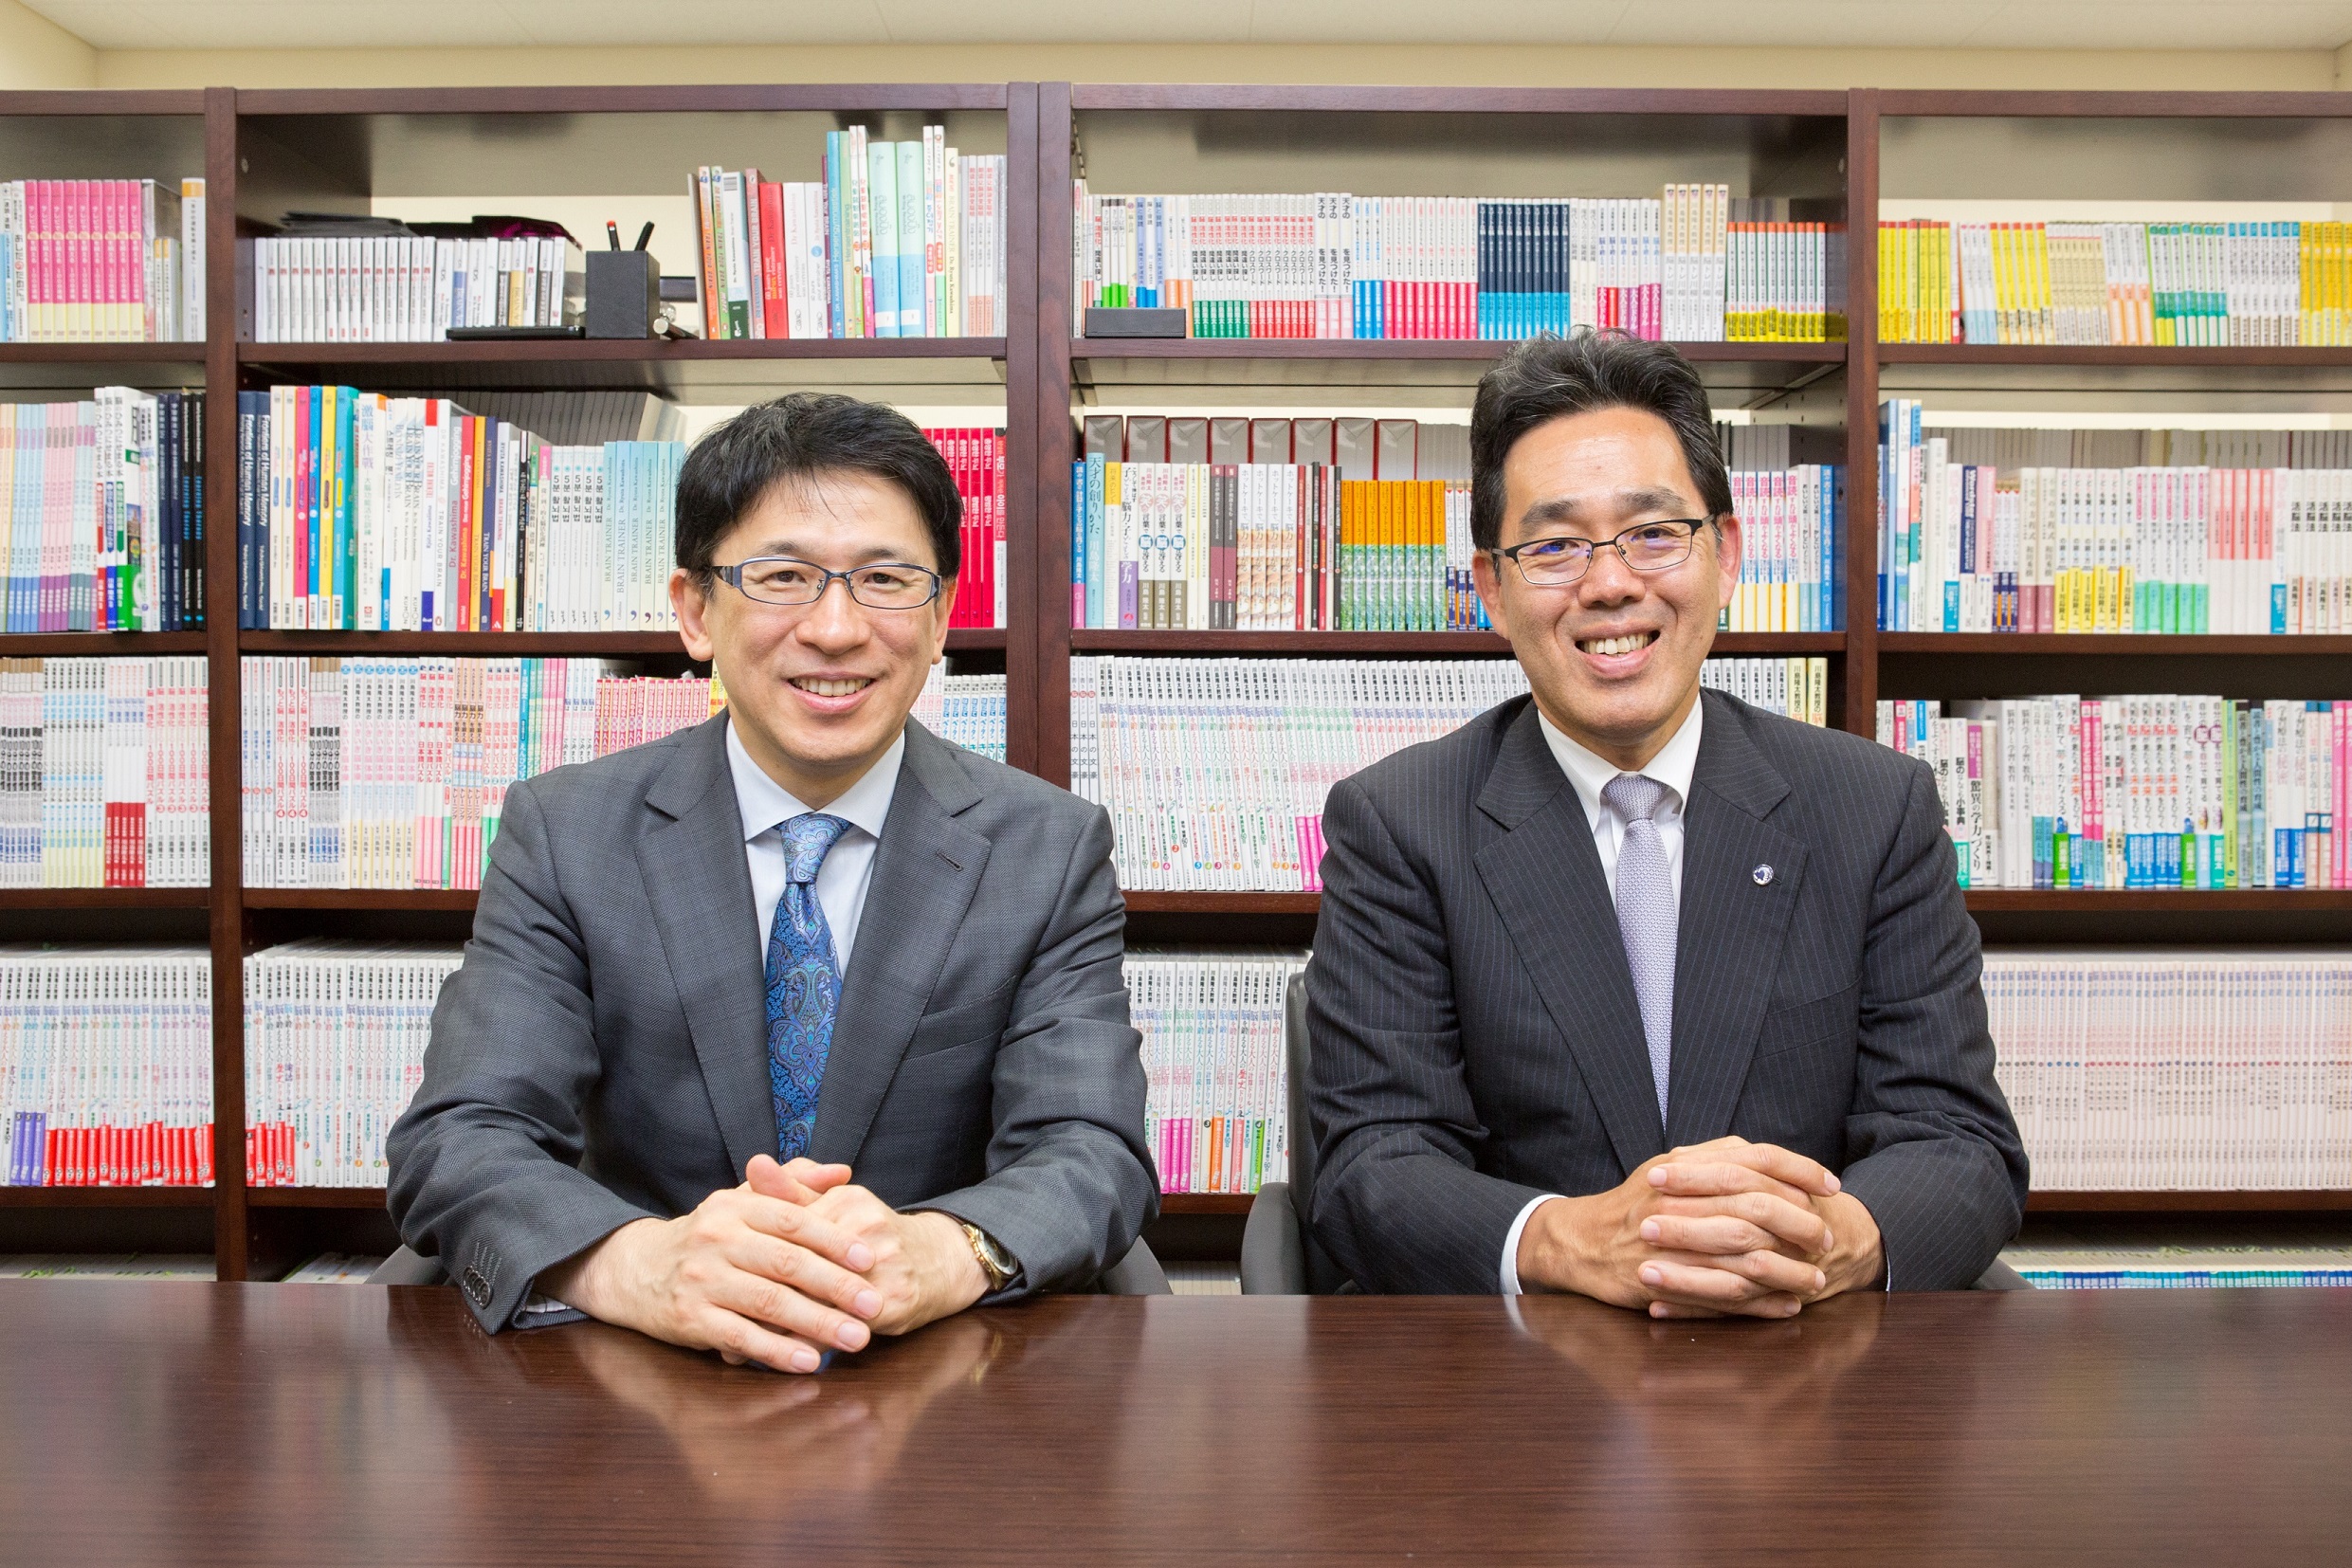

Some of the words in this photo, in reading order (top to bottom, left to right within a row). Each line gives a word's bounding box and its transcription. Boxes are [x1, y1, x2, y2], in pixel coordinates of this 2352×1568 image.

[245, 414, 254, 451] Frontiers
[261, 414, 270, 451] Frontiers
[245, 451, 253, 460] of
[261, 452, 269, 461] of
[449, 426, 462, 485] Gehirnjogging
[245, 461, 253, 491] Human
[261, 462, 269, 492] Human
[404, 480, 414, 508] BRAIN
[412, 480, 423, 509] BRAIN
[462, 455, 472, 500] Gehirnjogging
[243, 492, 253, 526] Memory
[259, 493, 269, 526] Memory
[1089, 457, 1102, 535] 天才の創りかた
[449, 501, 459, 553] Kawashima
[617, 519, 626, 562] TRAINER
[460, 527, 468, 567] Kawashima
[616, 564, 625, 593] BRAIN
[1080, 720, 1088, 779] 日本の文豪
[1089, 720, 1098, 779] 日本の文豪
